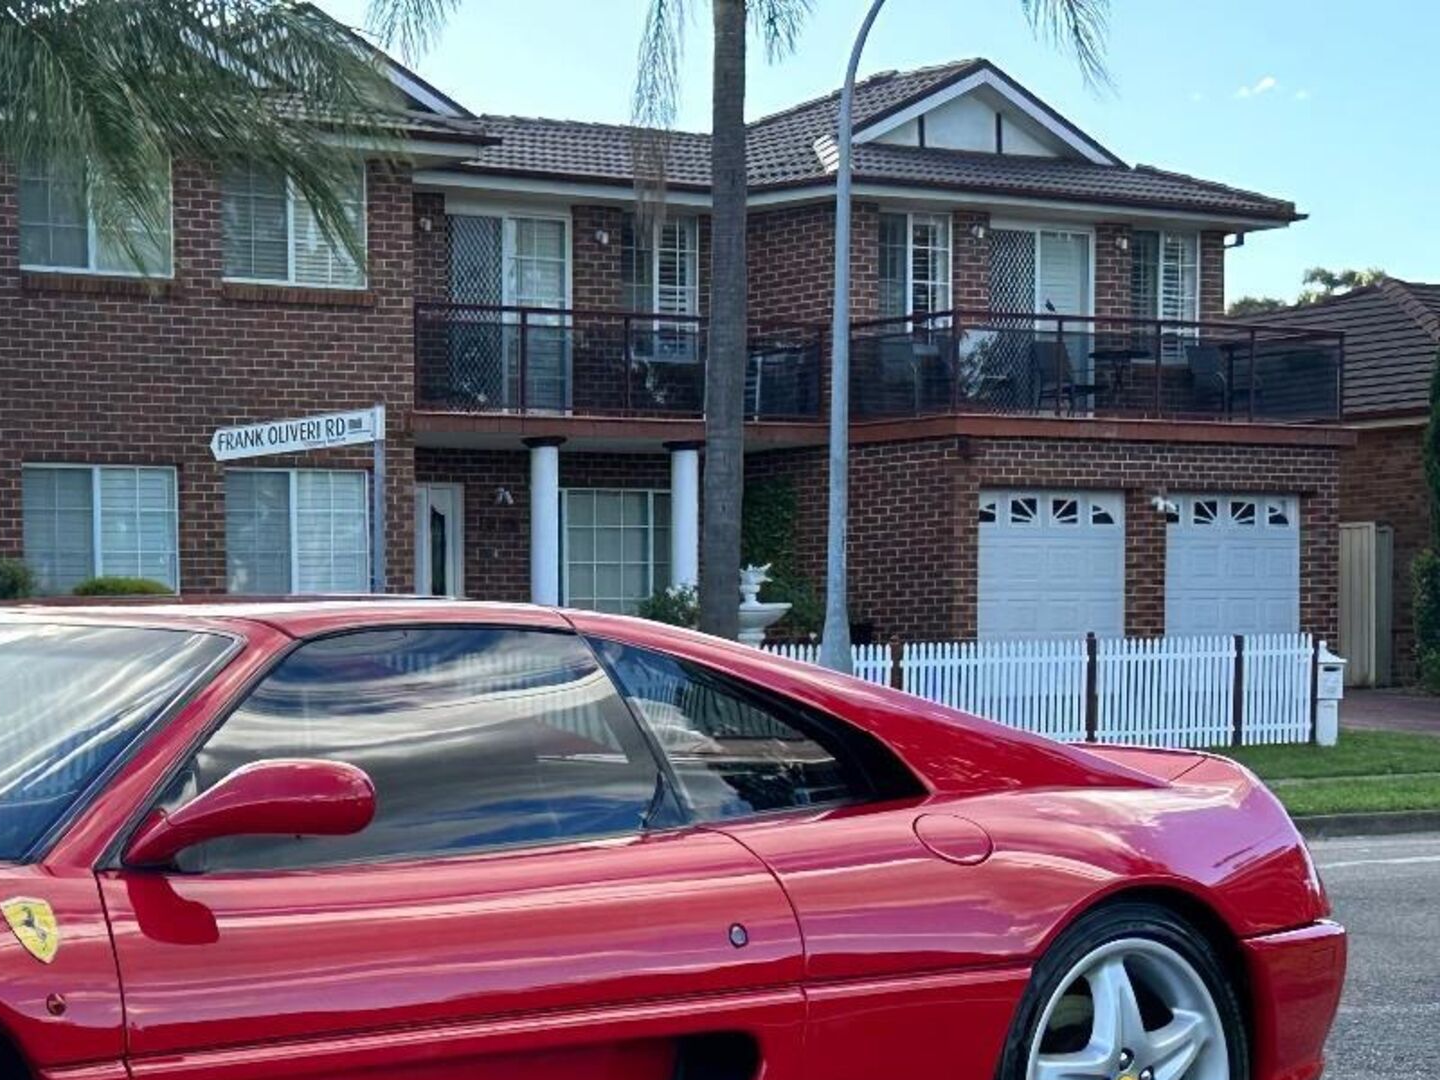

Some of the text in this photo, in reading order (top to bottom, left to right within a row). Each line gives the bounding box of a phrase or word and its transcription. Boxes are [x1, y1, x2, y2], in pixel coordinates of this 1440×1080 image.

[218, 428, 264, 451] FRANK
[268, 420, 321, 444] OLIVERI
[325, 417, 346, 437] RD
